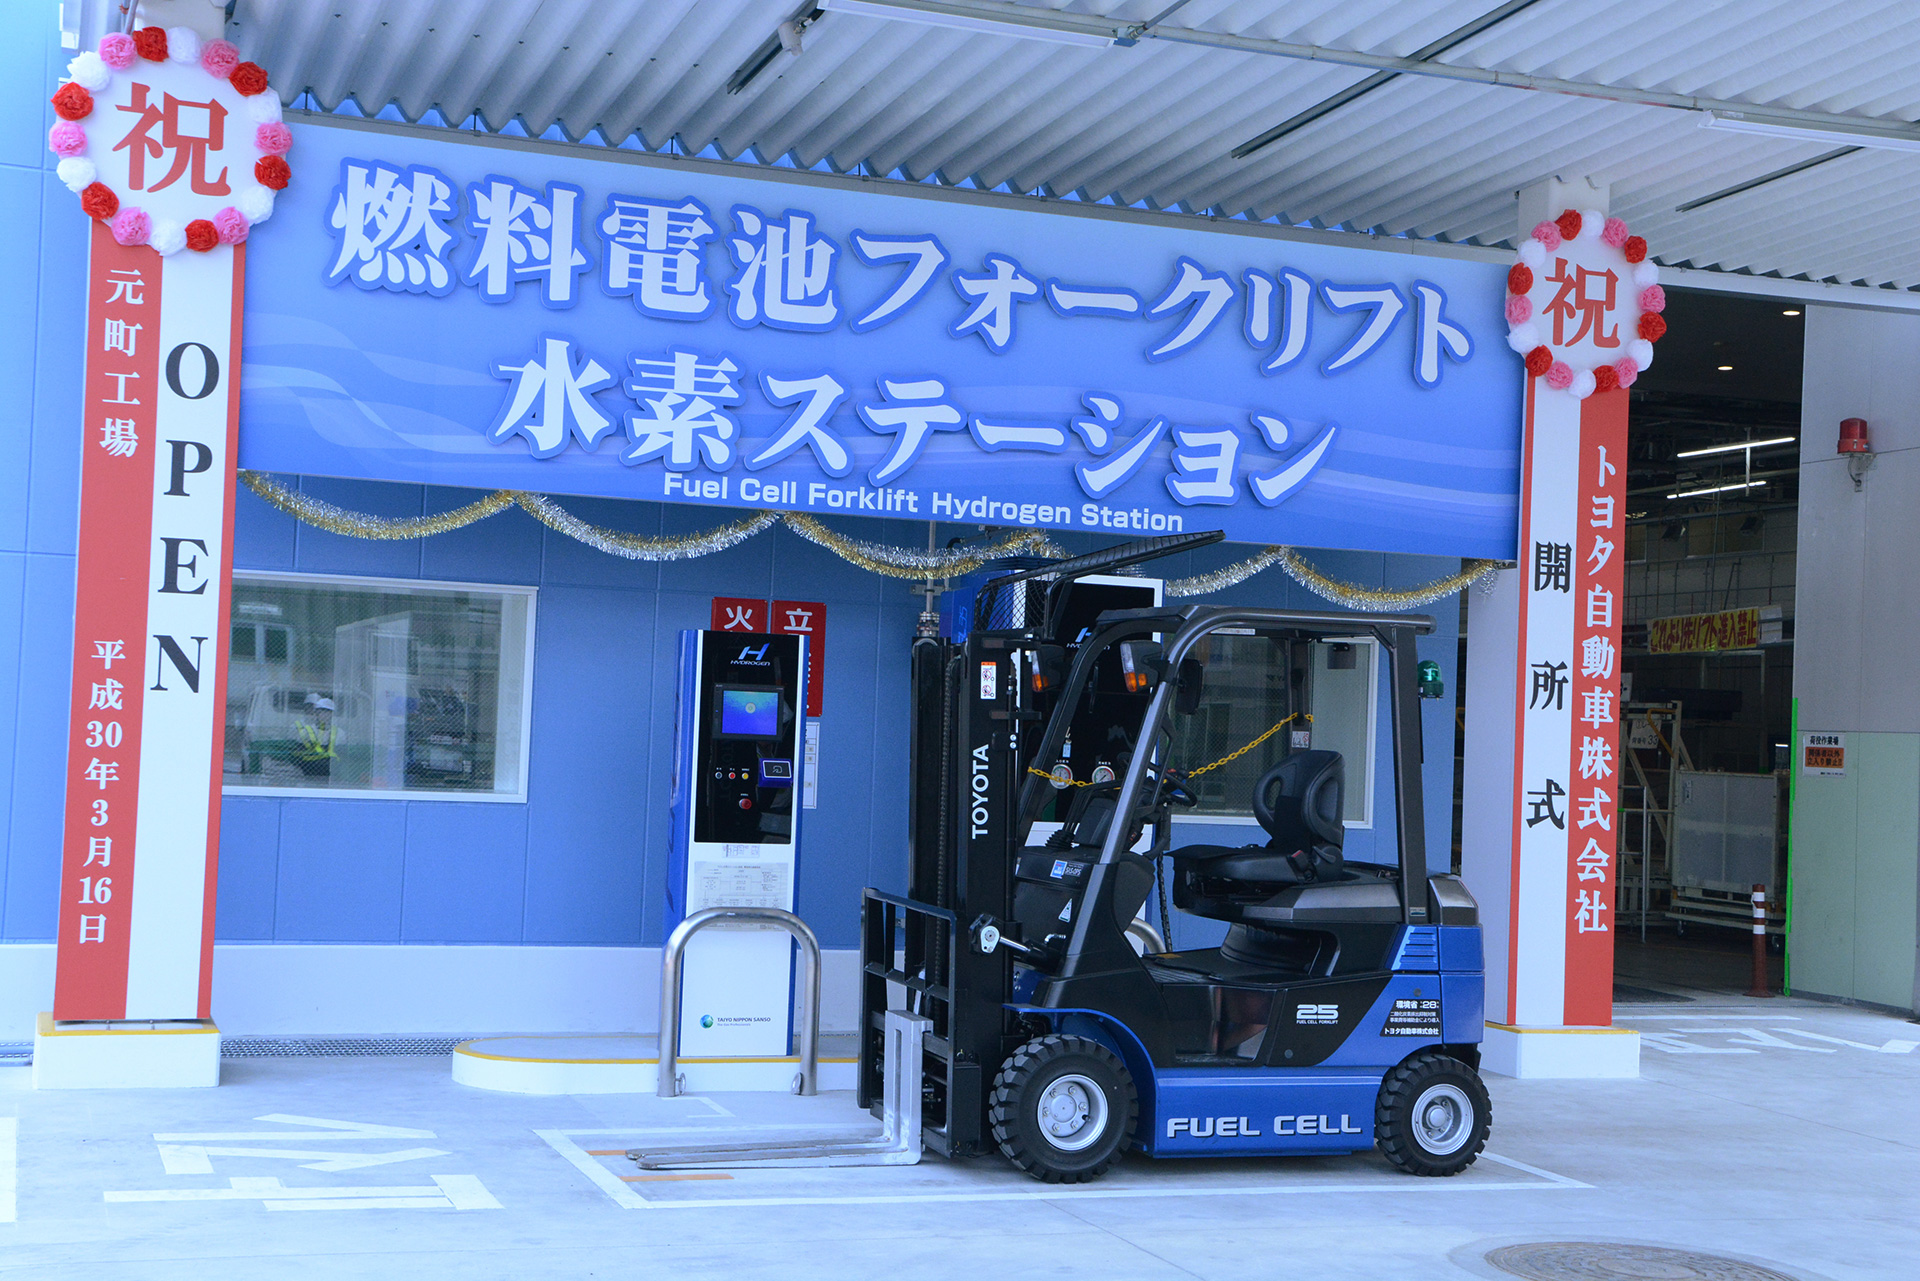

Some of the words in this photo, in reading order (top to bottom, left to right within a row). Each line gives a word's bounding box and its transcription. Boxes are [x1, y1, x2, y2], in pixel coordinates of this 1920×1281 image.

[112, 81, 232, 197] 祝
[328, 163, 1471, 385] 燃料電池フォークリフト
[1541, 257, 1621, 349] 祝
[99, 268, 146, 458] 元町工場
[493, 337, 1338, 503] 水素ステーション
[150, 341, 220, 693] OPEN
[663, 472, 729, 501] Fuel
[740, 477, 797, 505] Cell
[808, 483, 918, 513] Forklift
[932, 491, 1071, 526] Hydrogen
[1081, 502, 1184, 532] Station
[730, 659, 771, 667] HYDROGEN
[1525, 540, 1573, 830] 開所式
[1574, 445, 1616, 934] トヨタ自動車株式会社
[77, 638, 127, 946] 平成30年3月16日
[971, 743, 990, 840] TOYOTA
[1296, 1004, 1339, 1020] 25
[1166, 1117, 1260, 1138] FUEL
[1273, 1114, 1362, 1136] CELL
